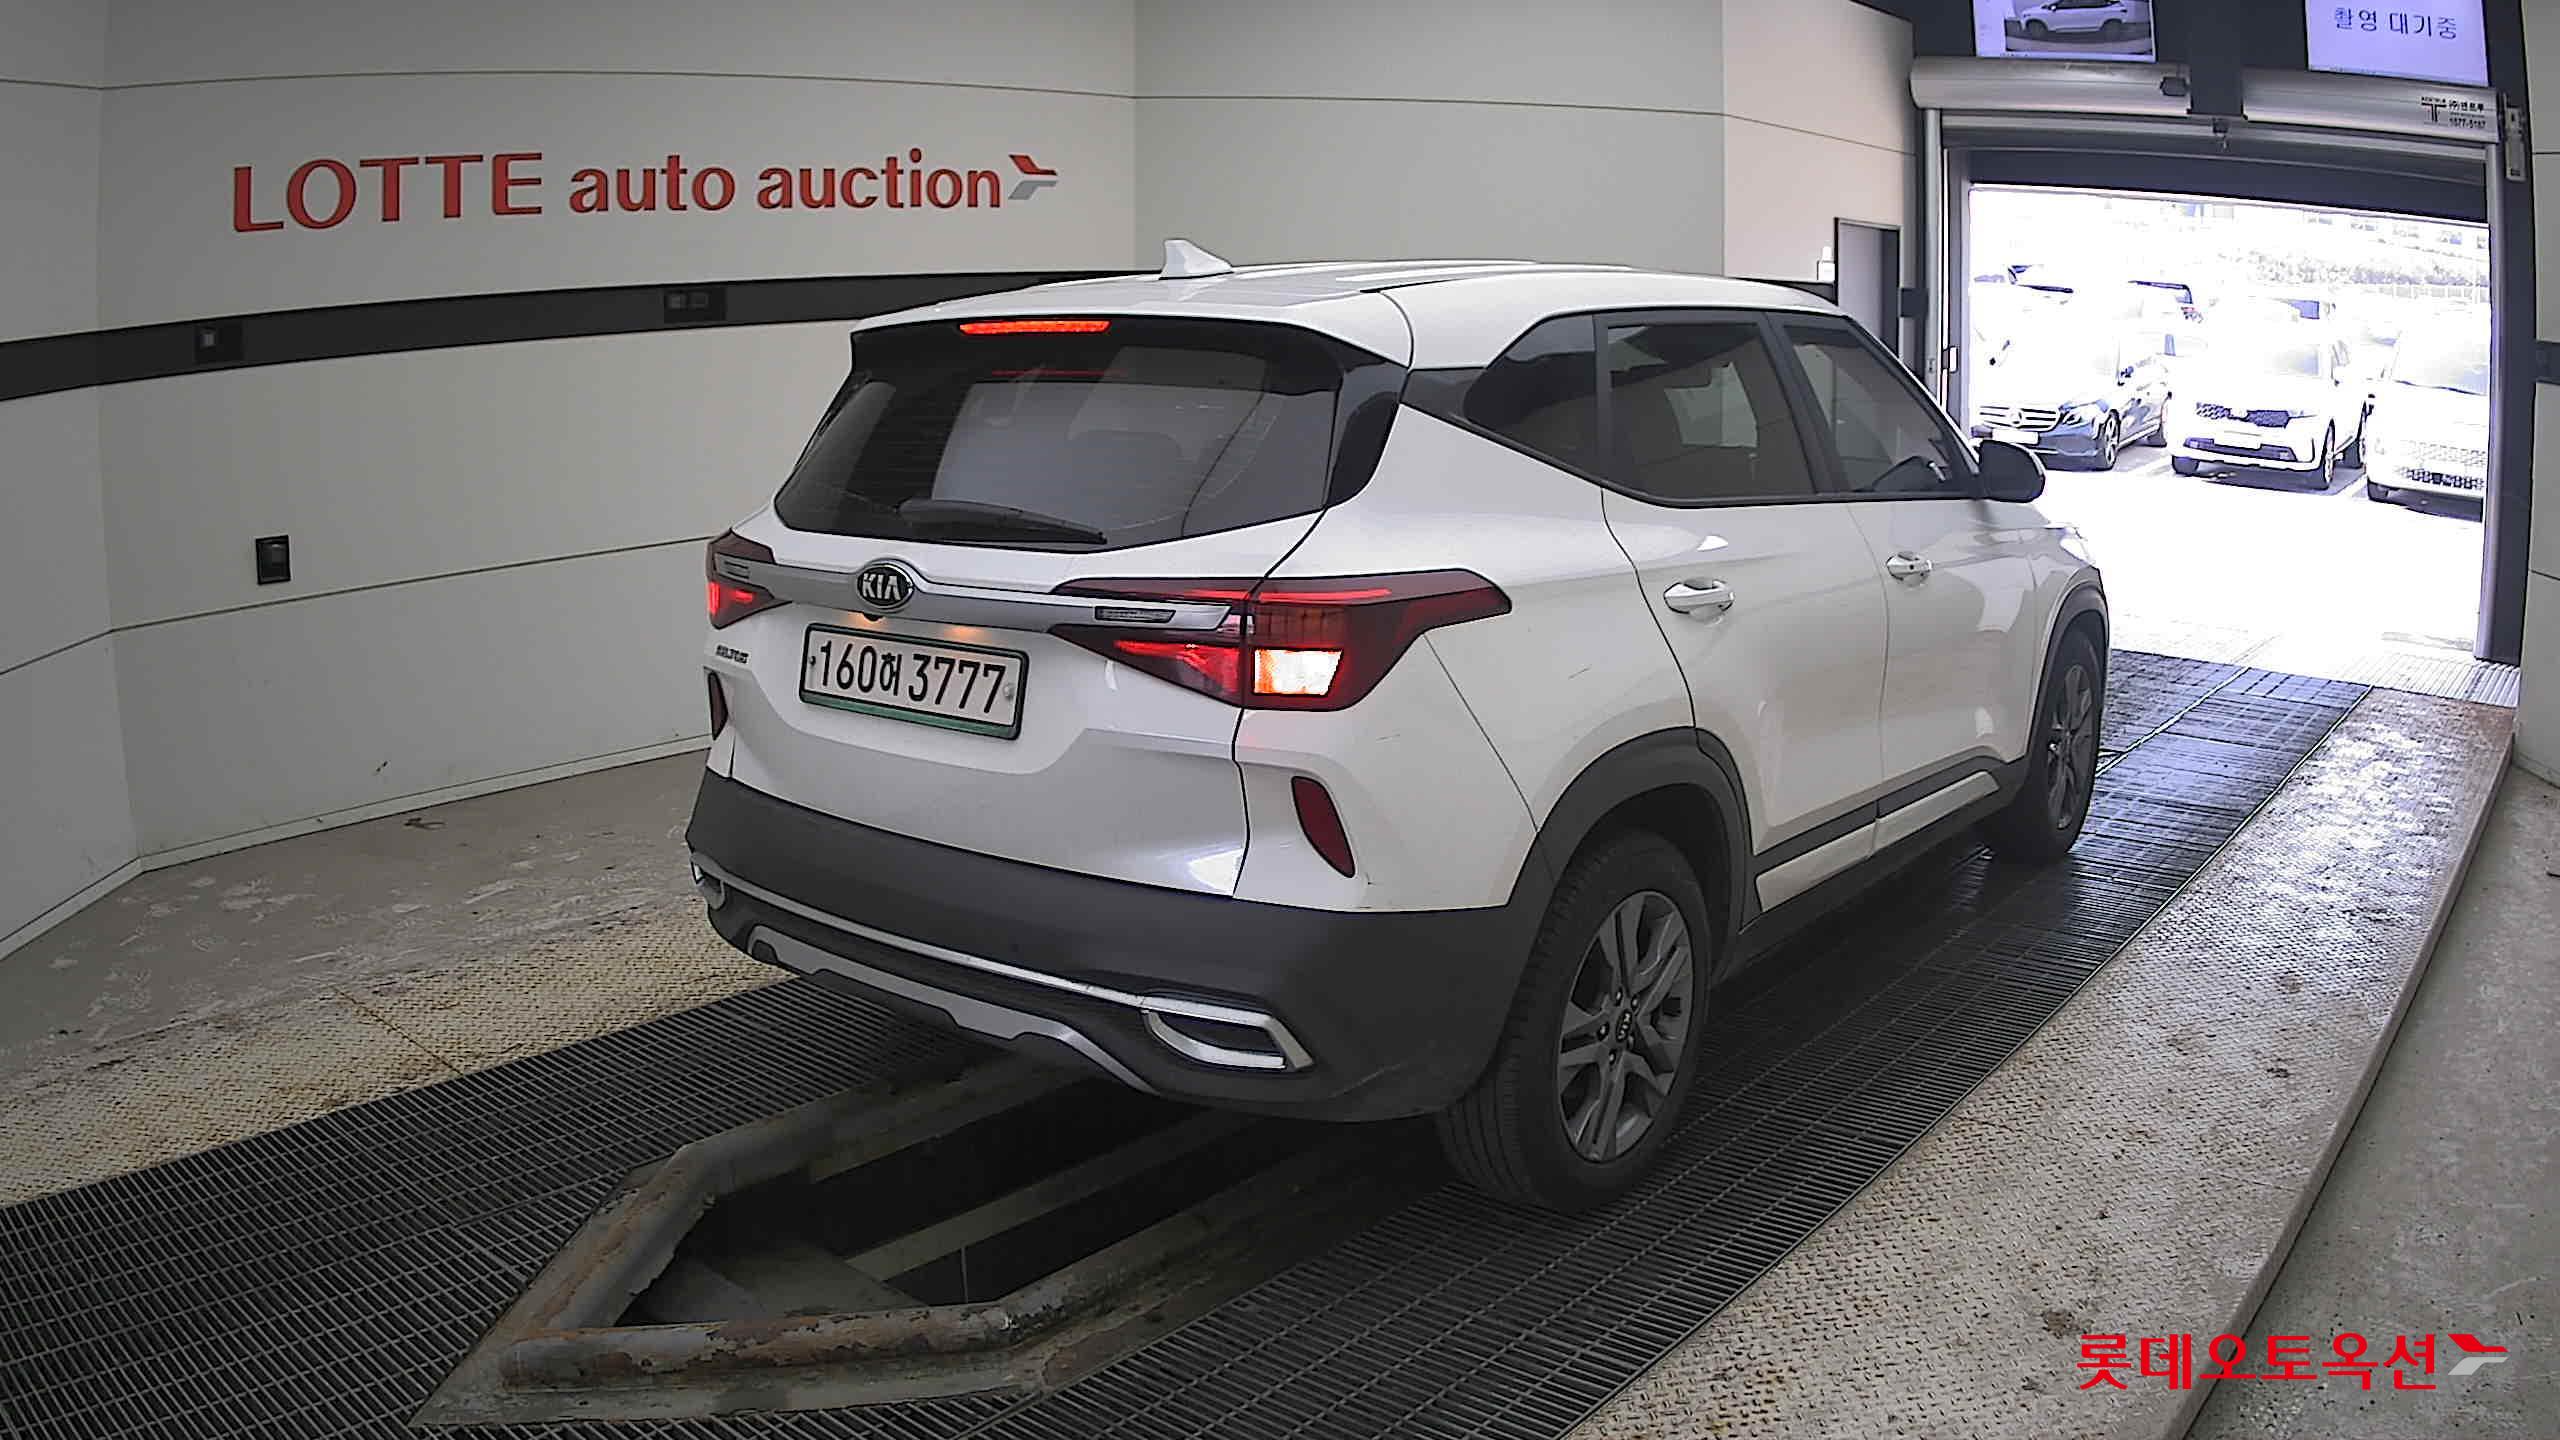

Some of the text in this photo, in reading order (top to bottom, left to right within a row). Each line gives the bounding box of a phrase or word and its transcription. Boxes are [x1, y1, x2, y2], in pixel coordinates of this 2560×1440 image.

[2335, 8, 2457, 40] 촬영 대기중
[233, 147, 1001, 234] LOTTE auto auction
[861, 572, 901, 601] KIA
